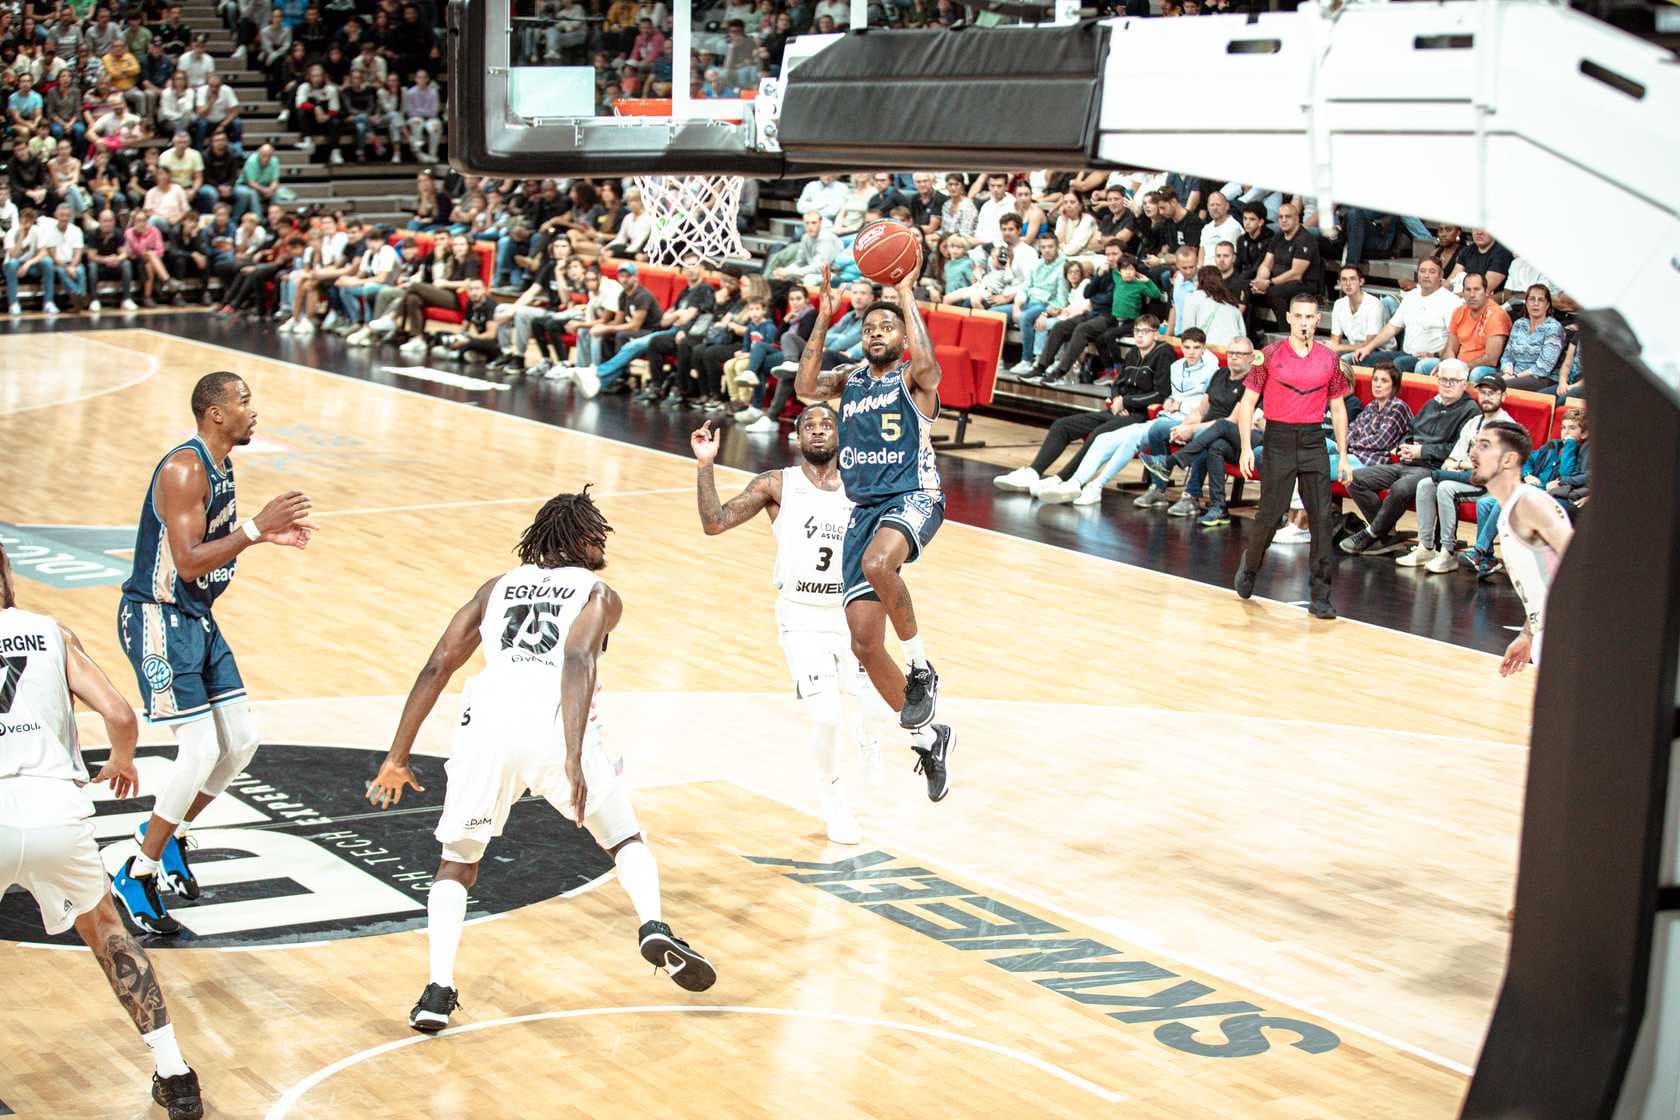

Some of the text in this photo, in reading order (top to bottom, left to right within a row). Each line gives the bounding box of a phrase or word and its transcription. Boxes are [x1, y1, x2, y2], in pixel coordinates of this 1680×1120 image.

[881, 413, 901, 442] 5
[854, 447, 906, 465] leader
[816, 547, 833, 572] 3
[740, 850, 1341, 1058] SKWEEK
